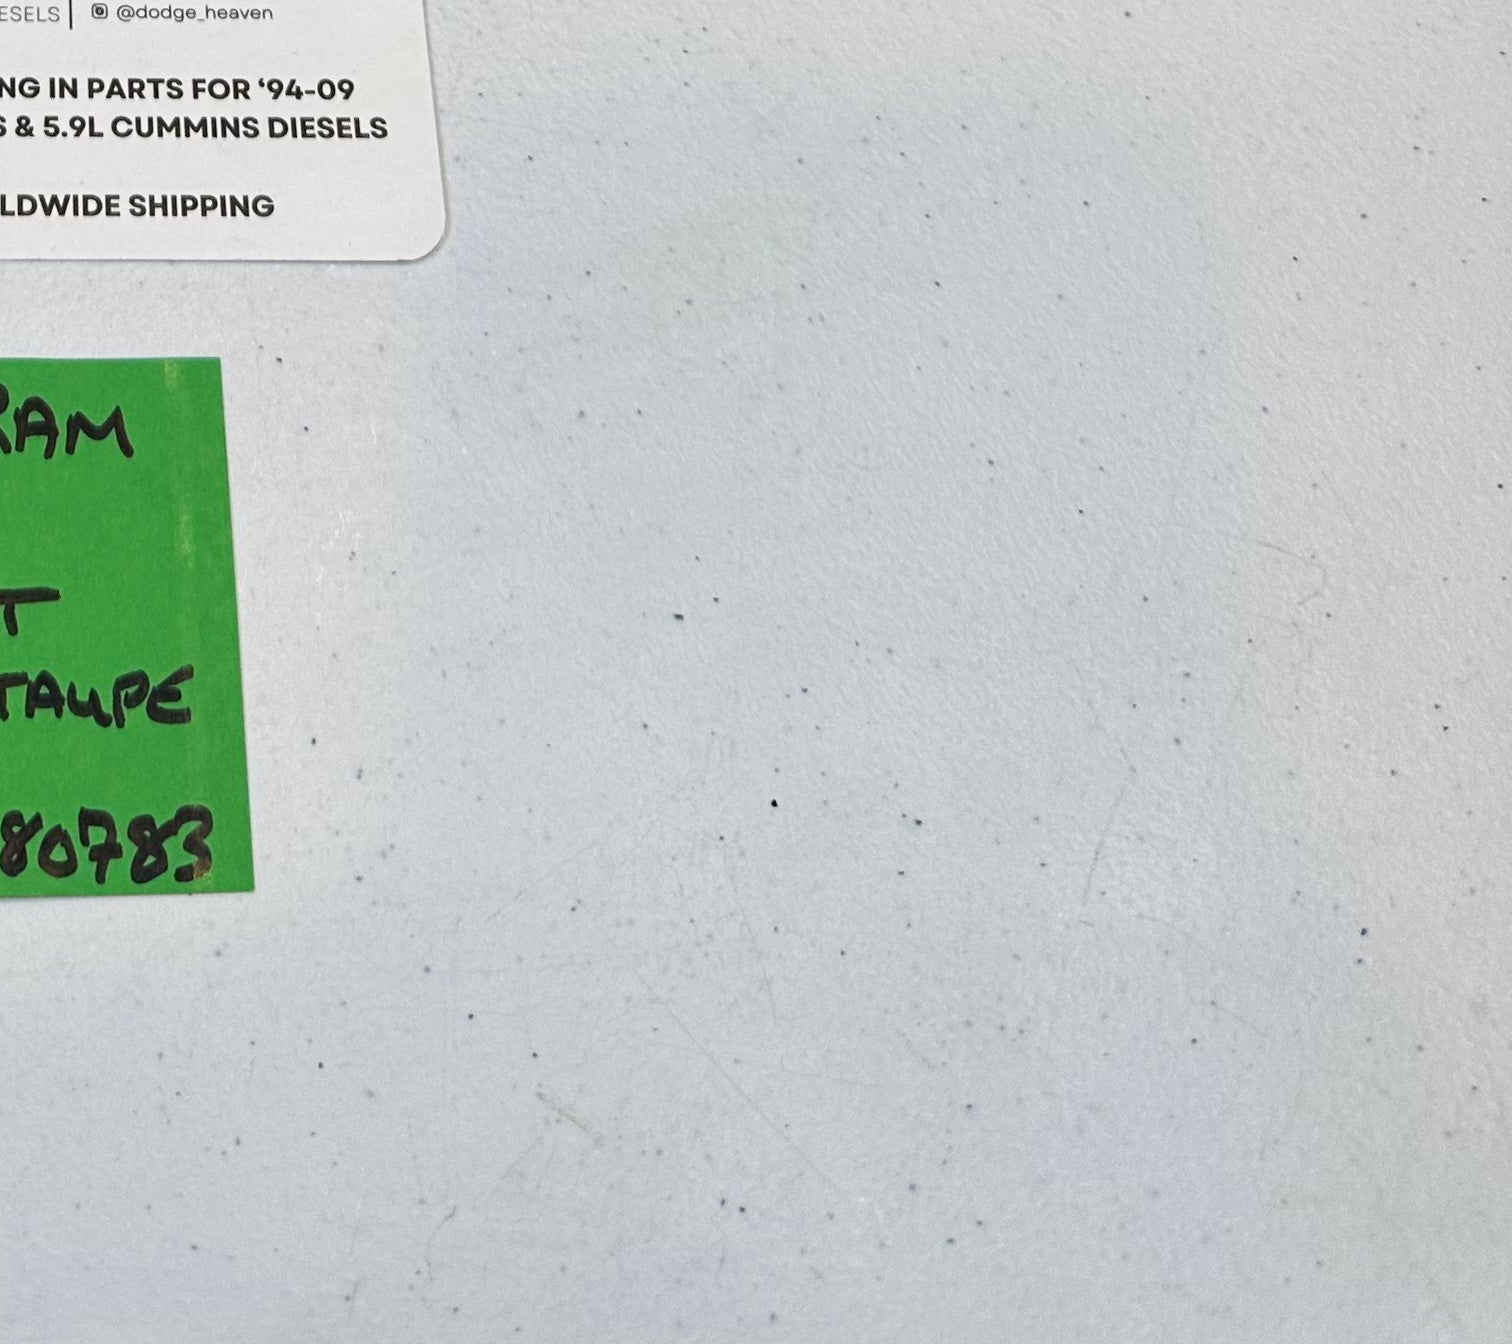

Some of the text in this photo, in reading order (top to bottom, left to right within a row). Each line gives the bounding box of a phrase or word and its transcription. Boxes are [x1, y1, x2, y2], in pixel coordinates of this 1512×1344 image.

[117, 5, 273, 22] @dodge_heaven
[49, 77, 78, 99] IN
[88, 78, 183, 99] PARTS
[192, 78, 250, 100] FOR
[15, 115, 35, 137] &
[44, 116, 104, 138] 5.9L
[111, 116, 259, 139] CUMMINS
[268, 117, 388, 139] DIESELS
[129, 194, 274, 217] SHIPPING
